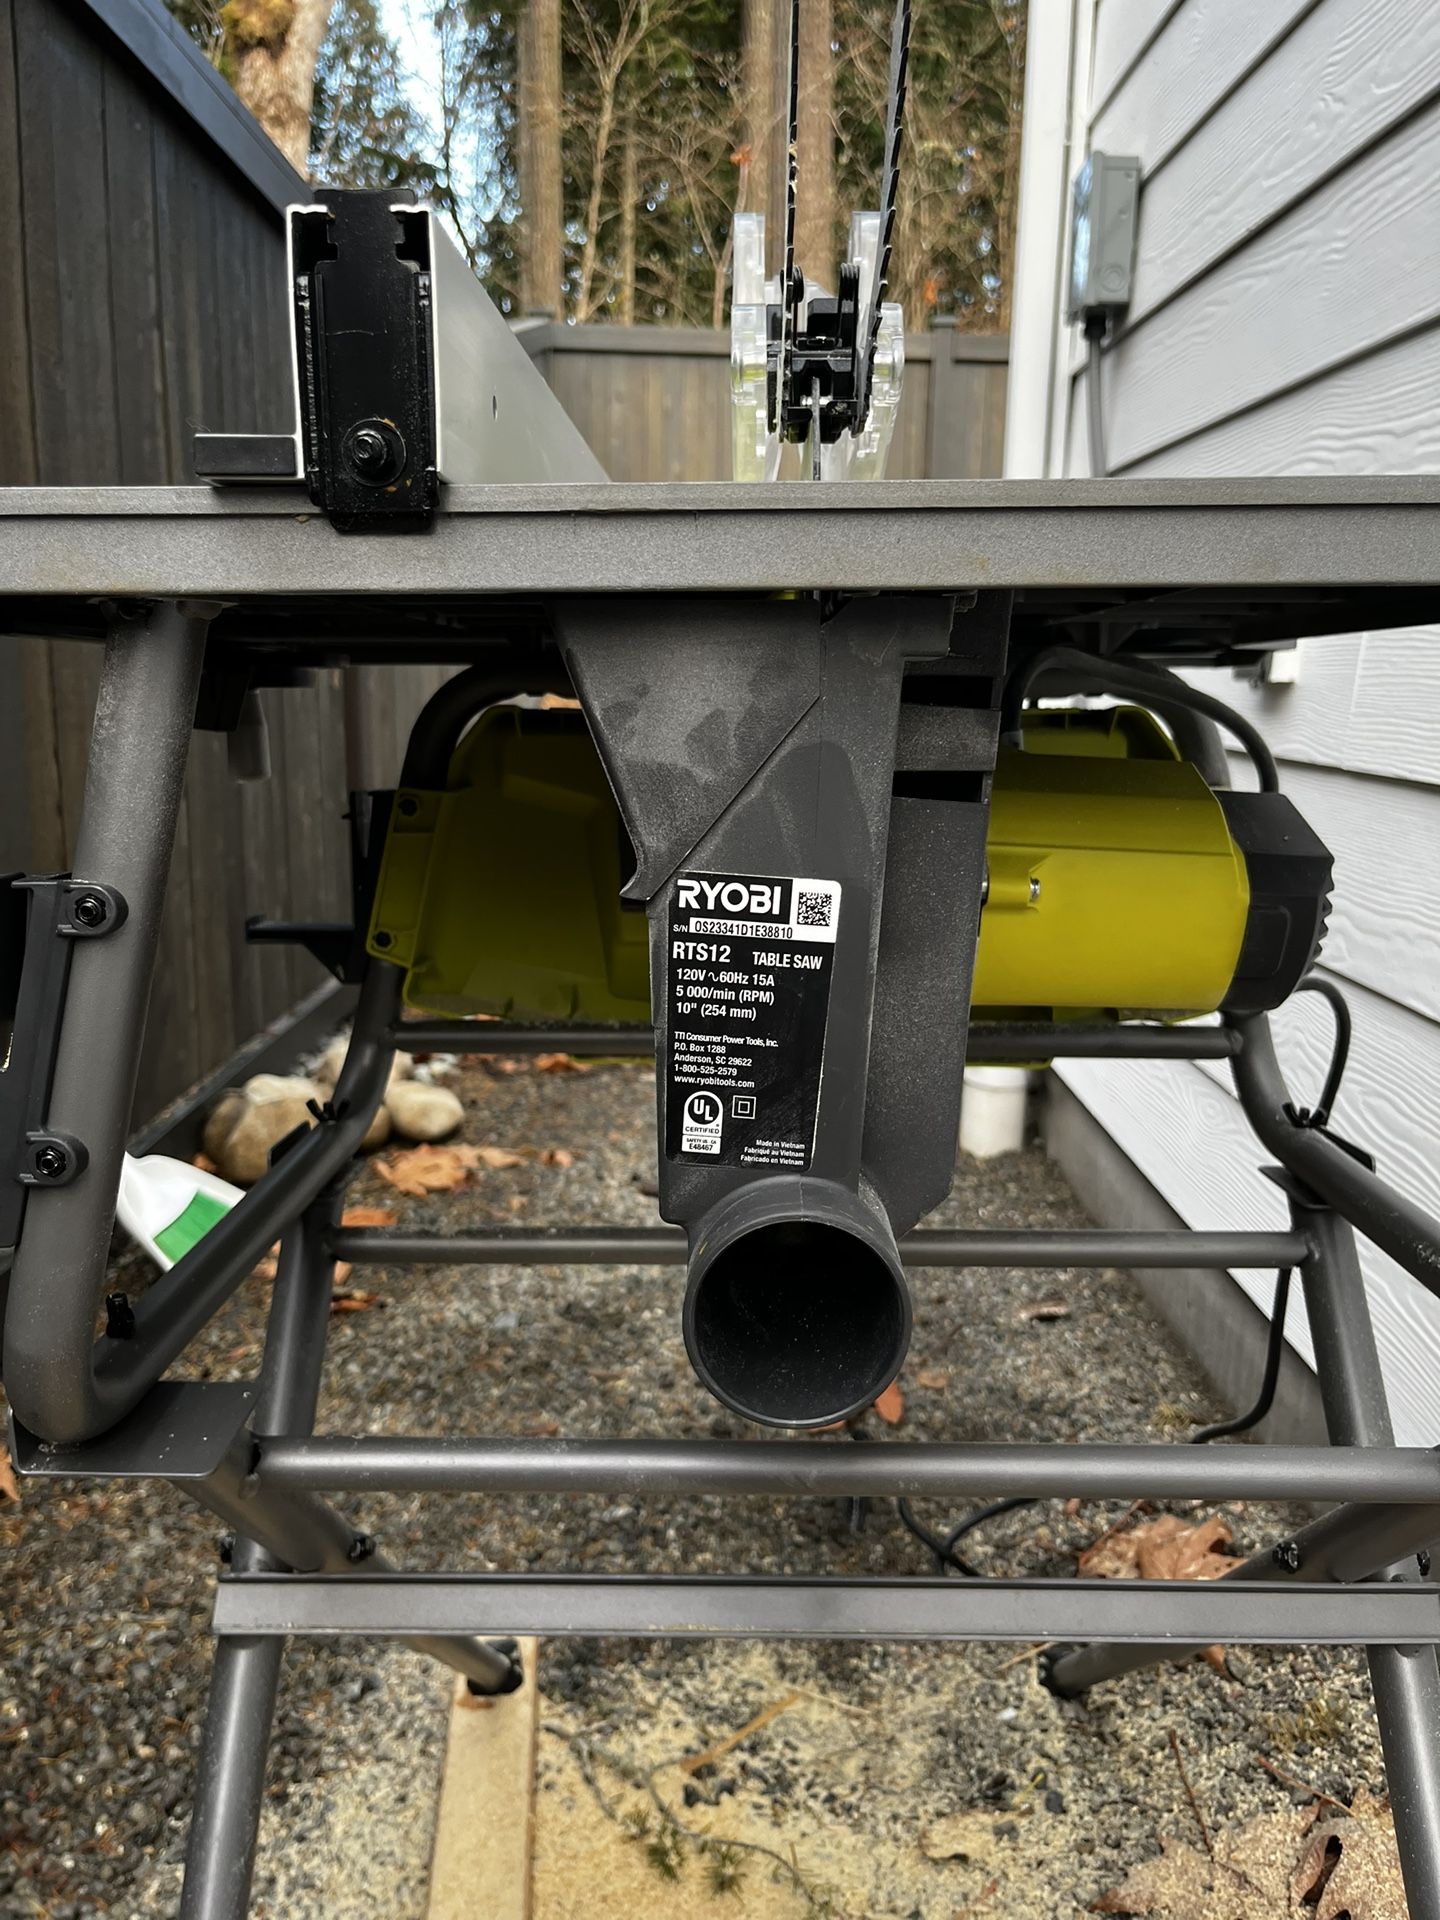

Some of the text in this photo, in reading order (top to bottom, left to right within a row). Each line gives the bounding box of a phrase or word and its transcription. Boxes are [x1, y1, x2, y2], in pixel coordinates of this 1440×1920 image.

[677, 879, 781, 915] RYOBI
[673, 924, 688, 932] S/N
[672, 941, 823, 970] RTS12 TABLE SAW
[677, 968, 775, 986] 120V 60Hz 15A
[676, 986, 775, 1005] 5 000/min (RPM)
[676, 1002, 756, 1020] 10" (254 mm)
[675, 1032, 778, 1047] TTI Consumer Power Tools, Inc.
[675, 1042, 726, 1053] P.O. Box 1288
[674, 1053, 752, 1066] Anderson, SC 29622
[675, 1064, 737, 1076] 1-800-525-2579
[675, 1075, 754, 1088] www.ryobitools.com
[694, 1099, 713, 1121] UL
[685, 1126, 719, 1134] CERTIFIED
[744, 1147, 770, 1155] Fabriqué
